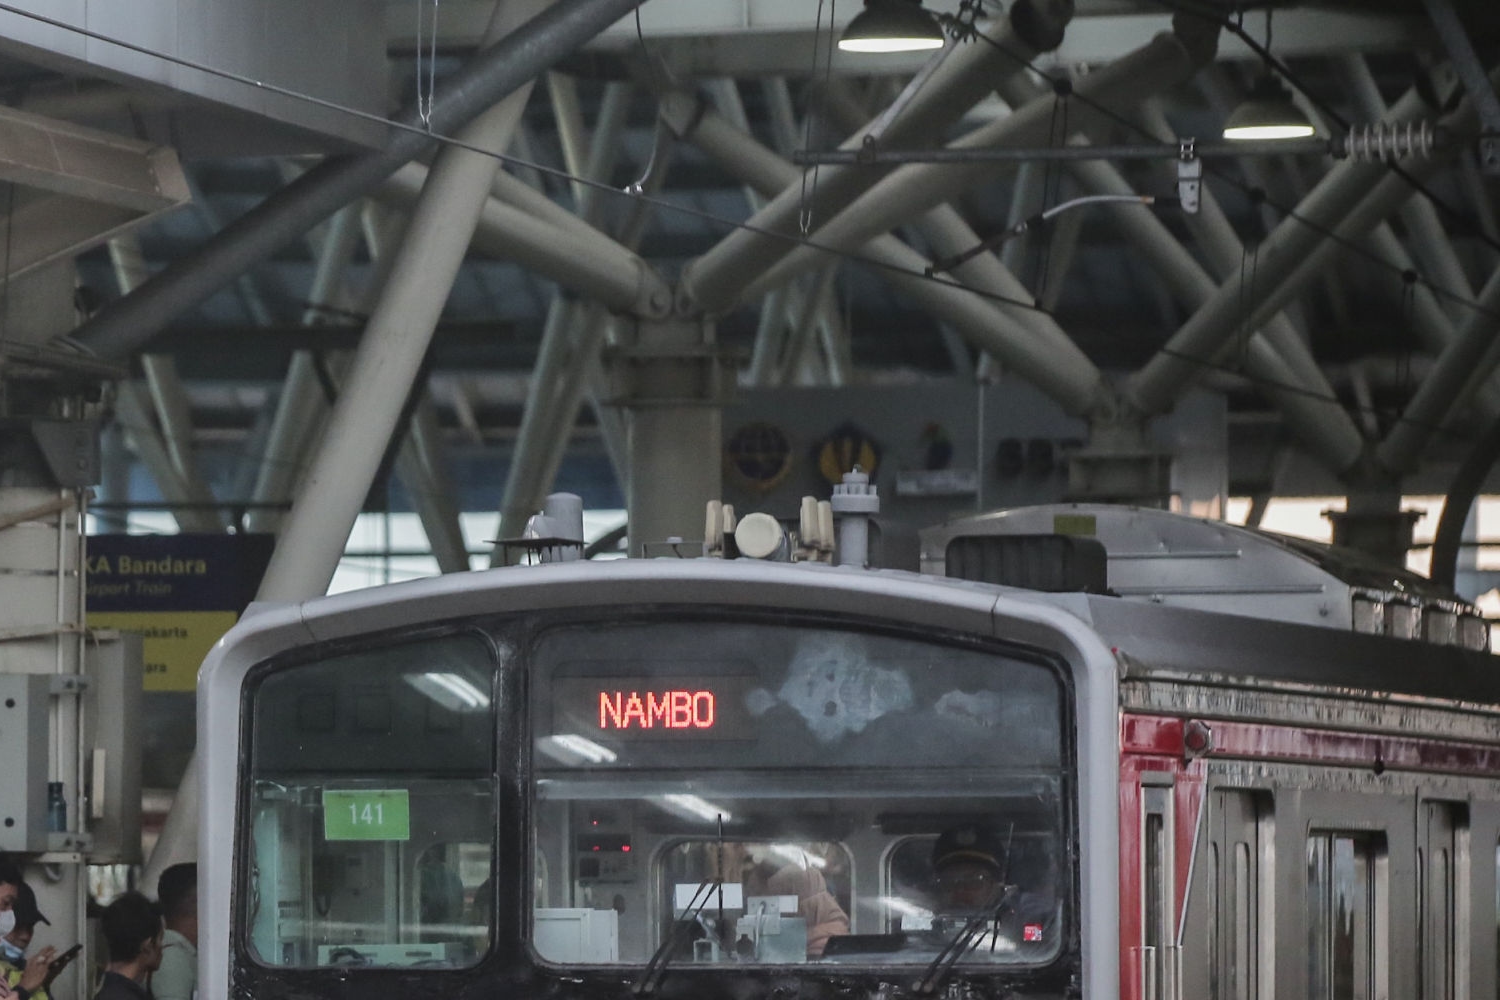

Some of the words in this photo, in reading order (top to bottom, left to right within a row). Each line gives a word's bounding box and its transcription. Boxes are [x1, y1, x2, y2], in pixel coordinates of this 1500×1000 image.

[118, 554, 207, 574] Bandara
[86, 582, 130, 597] irport
[599, 690, 715, 729] NAMBO
[348, 802, 384, 825] 141
